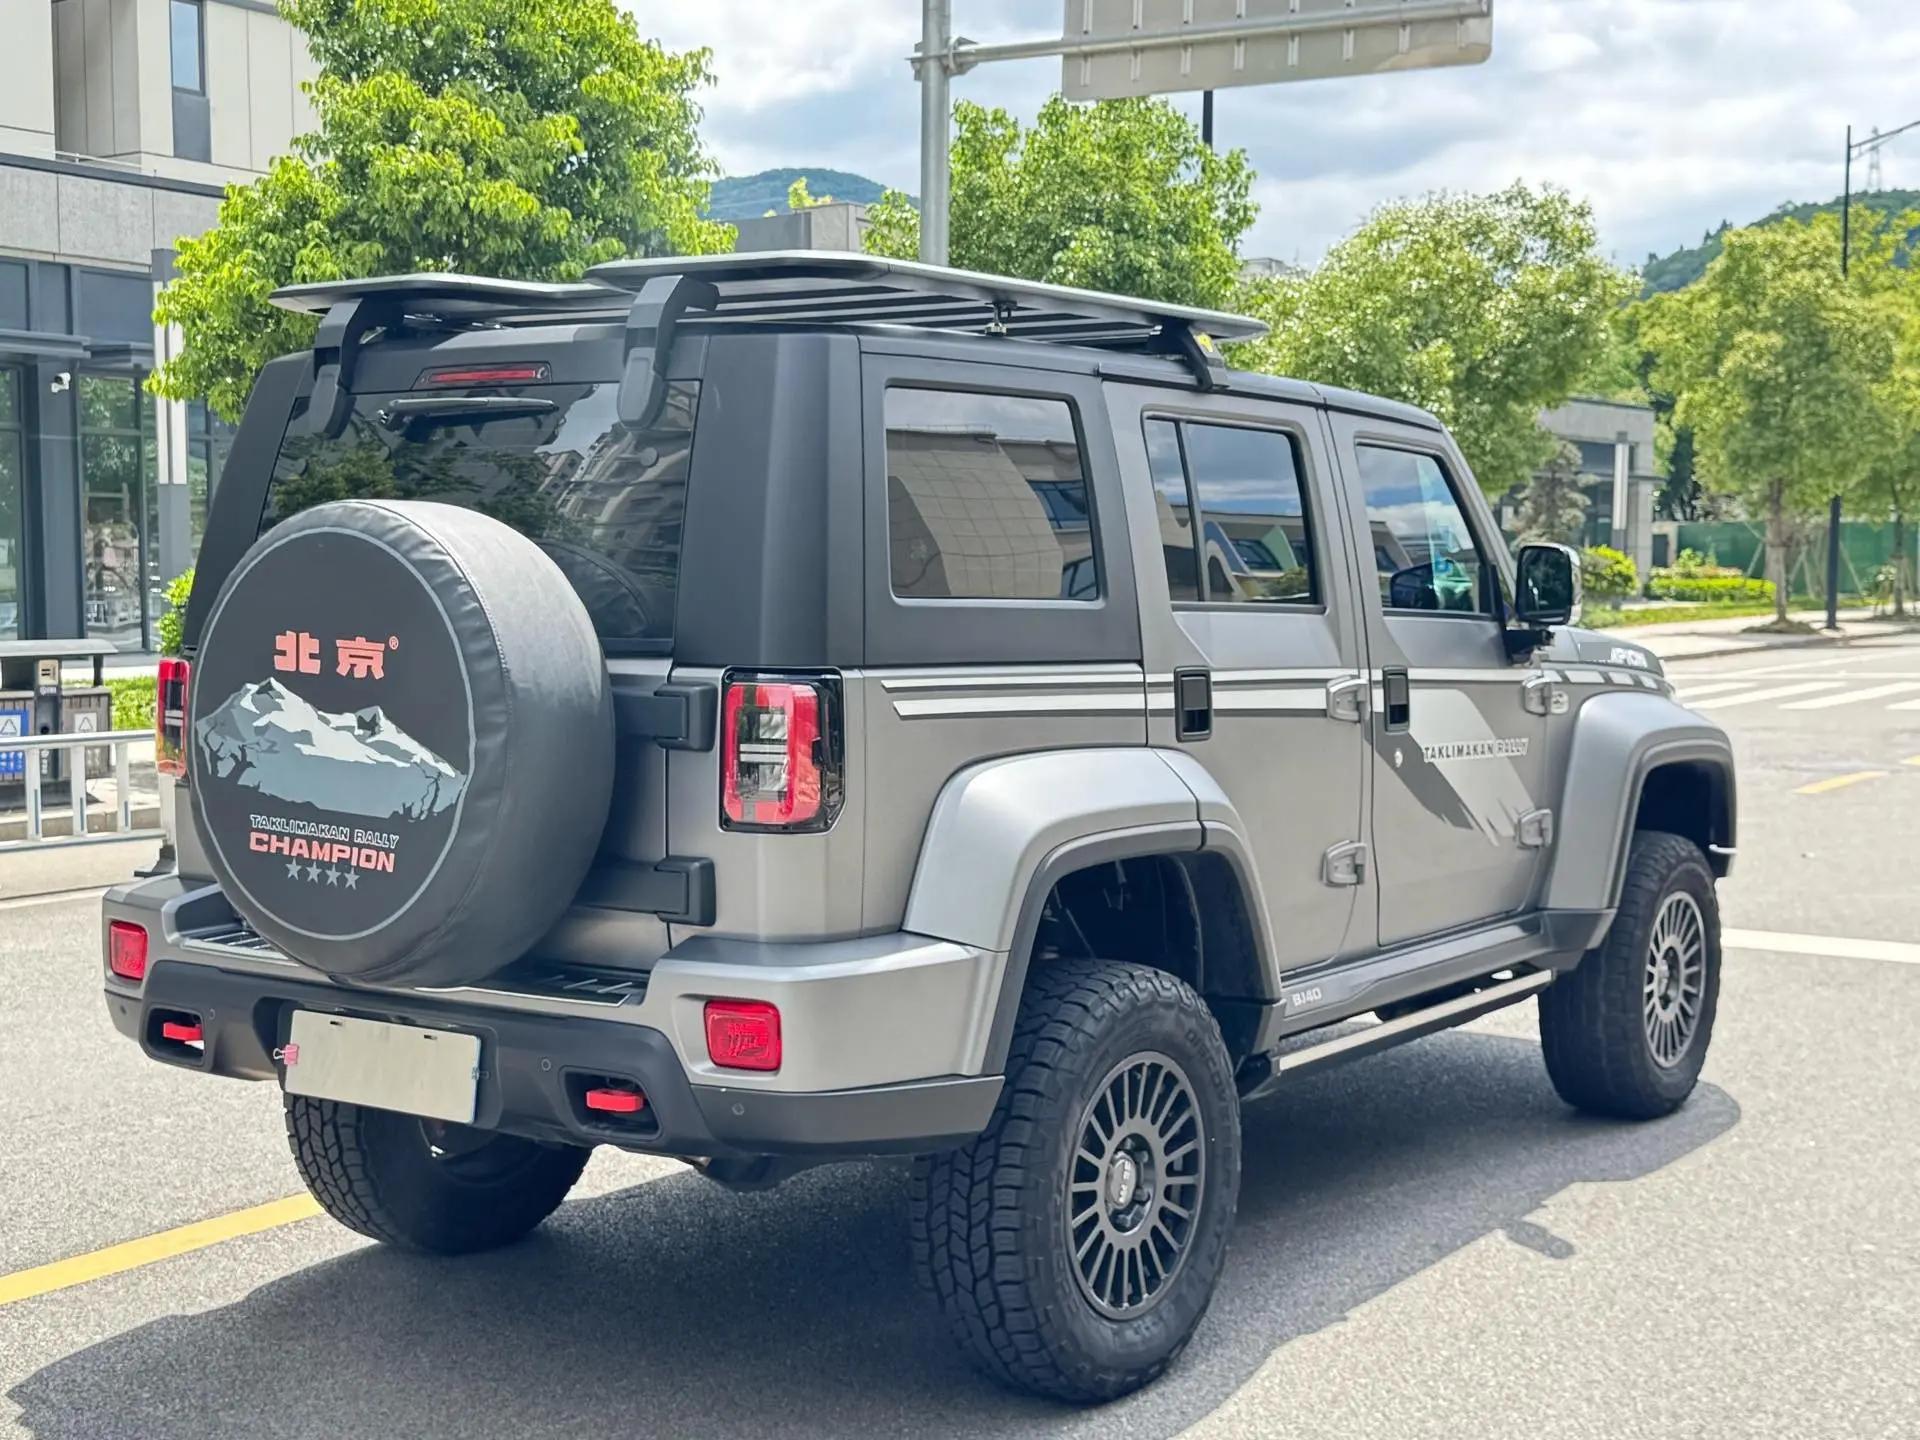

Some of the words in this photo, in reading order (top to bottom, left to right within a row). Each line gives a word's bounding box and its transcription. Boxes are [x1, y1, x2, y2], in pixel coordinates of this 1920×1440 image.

[1424, 742, 1494, 762] TAKLIMAKAN
[250, 814, 350, 842] TAKLIMAKAN
[354, 829, 400, 848] RALLY
[249, 831, 395, 873] CHAMPION
